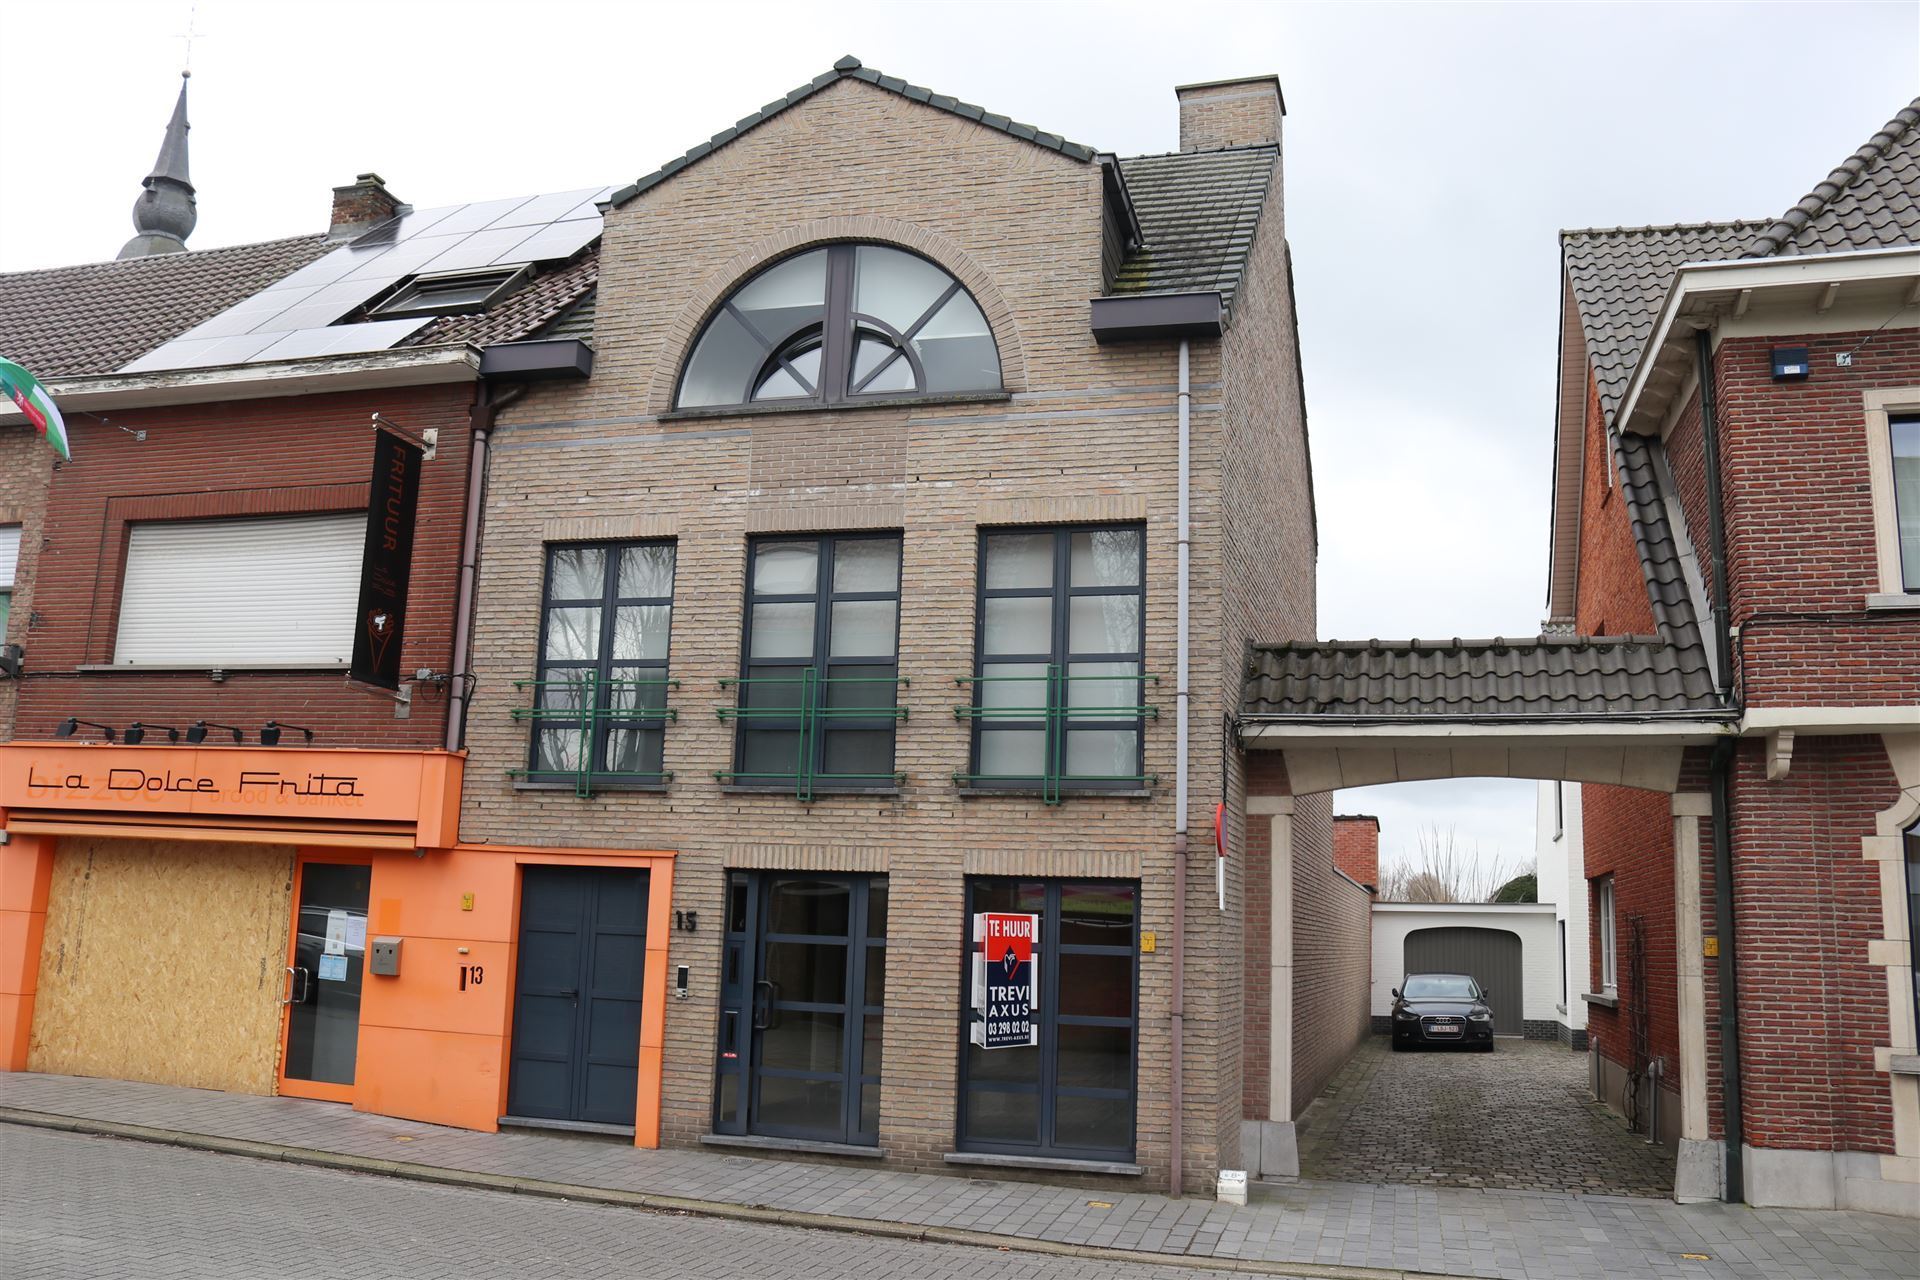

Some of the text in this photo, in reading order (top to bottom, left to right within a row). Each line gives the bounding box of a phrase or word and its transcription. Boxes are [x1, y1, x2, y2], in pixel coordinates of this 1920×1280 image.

[381, 445, 406, 552] FRITUUR
[28, 766, 365, 797] La Dolce Frita
[676, 910, 697, 932] 15
[989, 919, 1031, 938] TE HUUR
[469, 966, 484, 985] 13
[989, 985, 1030, 1002] TREVI
[988, 1003, 1029, 1018] AXUS
[988, 1019, 1030, 1036] 03 298 02 02
